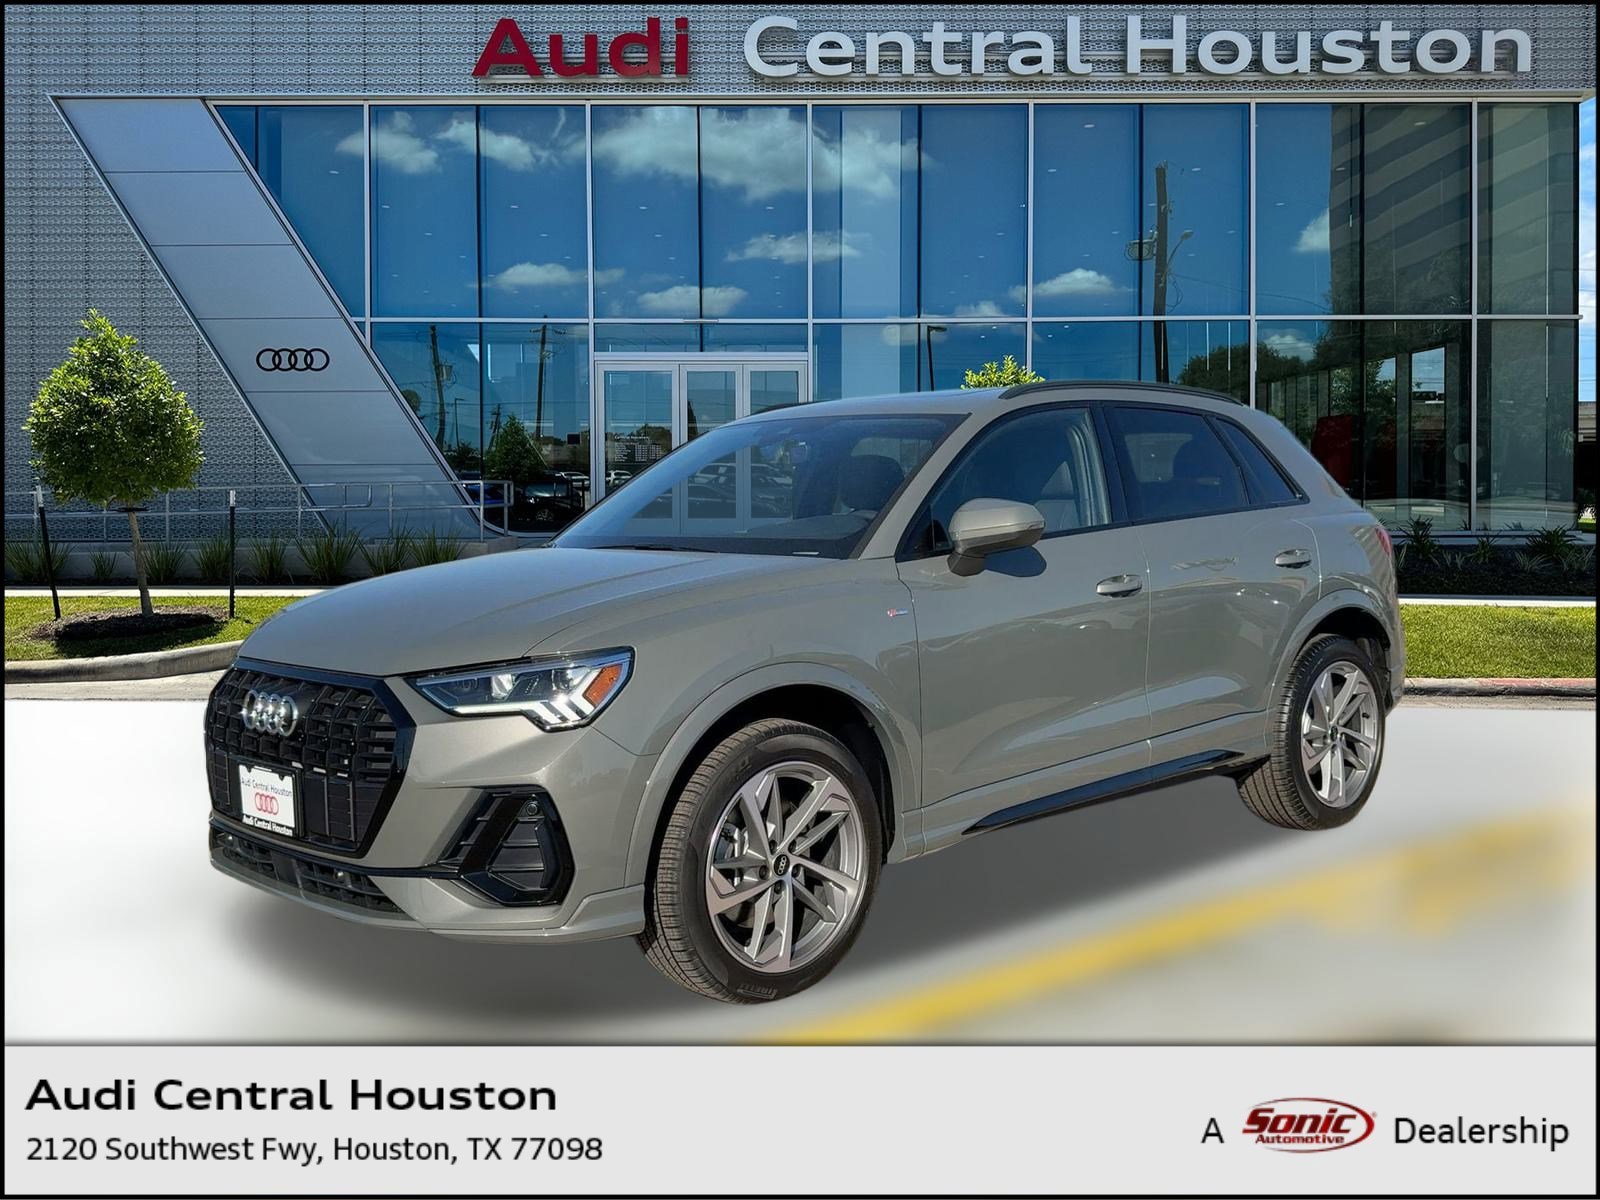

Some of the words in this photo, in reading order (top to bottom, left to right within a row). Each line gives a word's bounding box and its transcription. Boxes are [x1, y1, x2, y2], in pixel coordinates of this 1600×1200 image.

[472, 16, 689, 78] Audi
[743, 15, 1093, 77] Central
[1126, 15, 1531, 75] Houston
[252, 779, 270, 792] Central
[271, 784, 293, 797] Houston
[242, 814, 254, 826] Audi
[254, 817, 272, 831] Central
[272, 822, 293, 837] Houston
